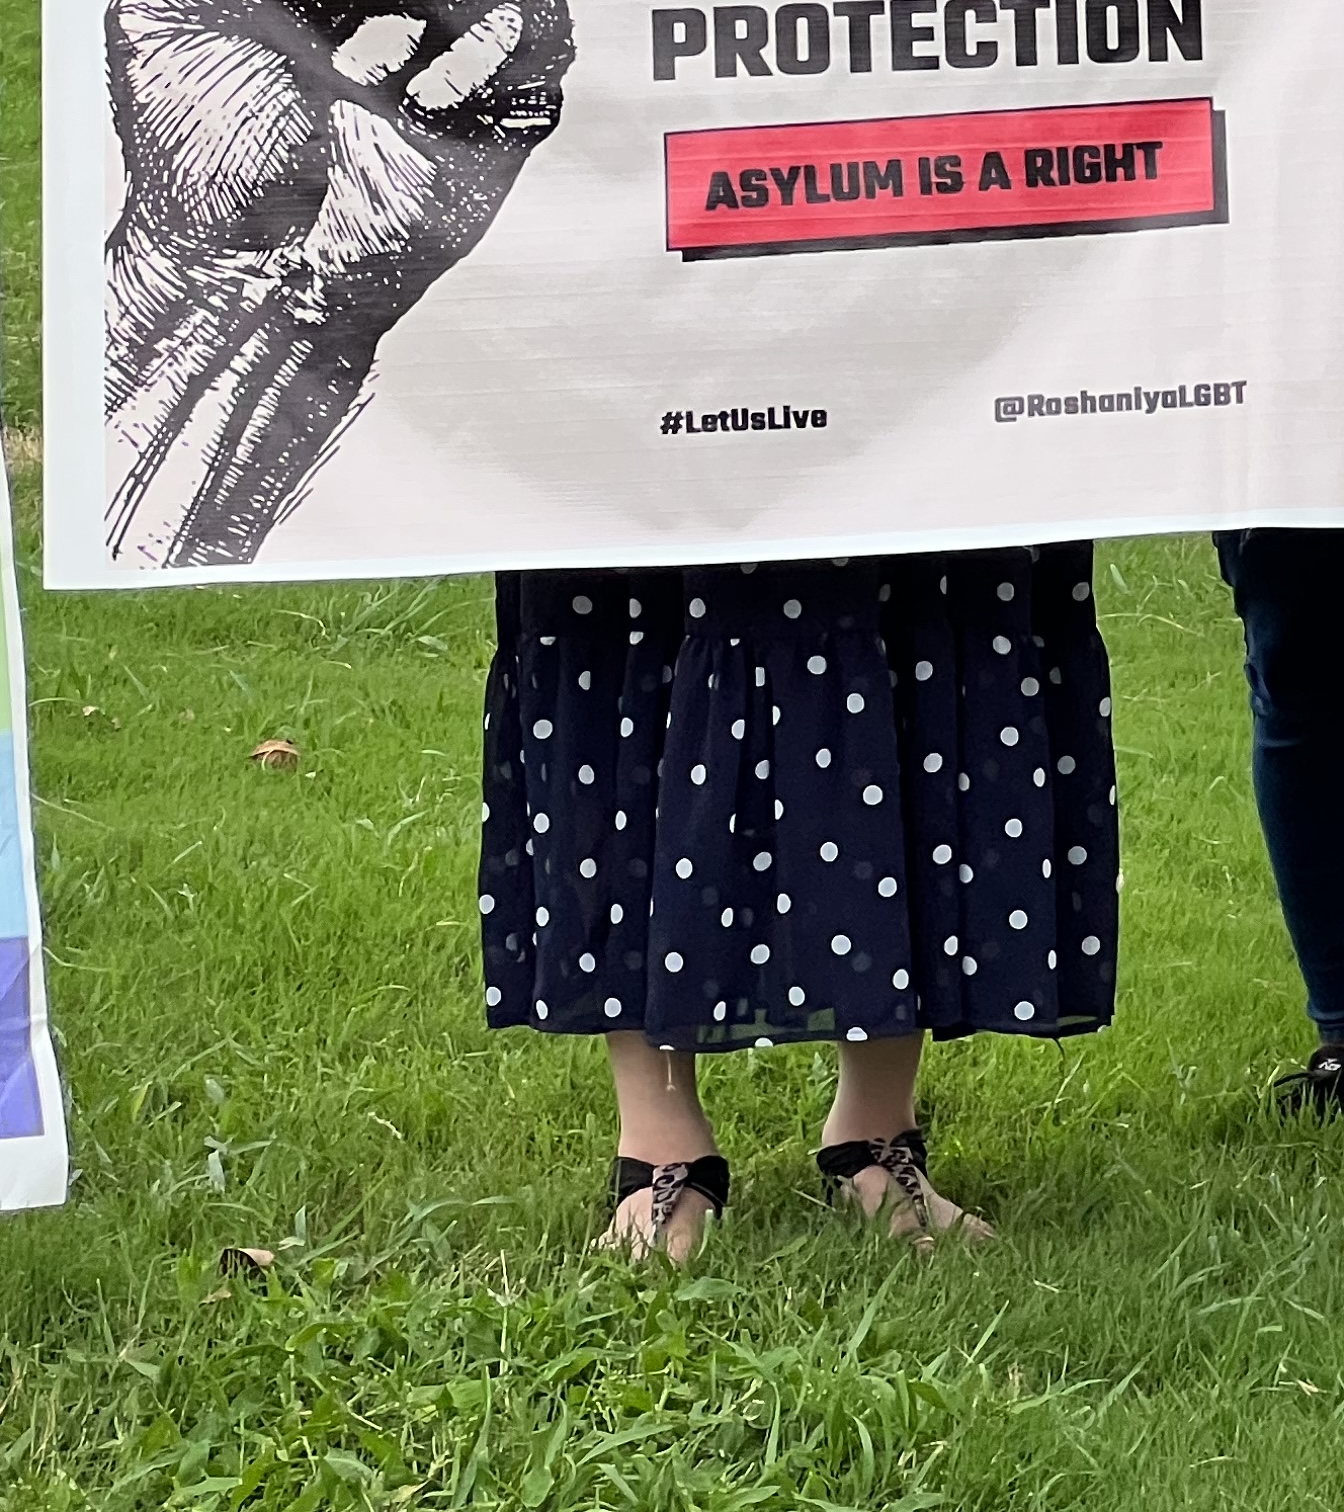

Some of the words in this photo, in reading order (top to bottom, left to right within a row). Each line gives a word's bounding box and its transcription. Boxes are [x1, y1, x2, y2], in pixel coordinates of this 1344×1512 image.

[705, 158, 904, 211] ASYLUM
[918, 154, 965, 196] IS
[978, 151, 1012, 192] A
[1023, 140, 1163, 189] RIGHT
[659, 405, 828, 435] #LetUsLive
